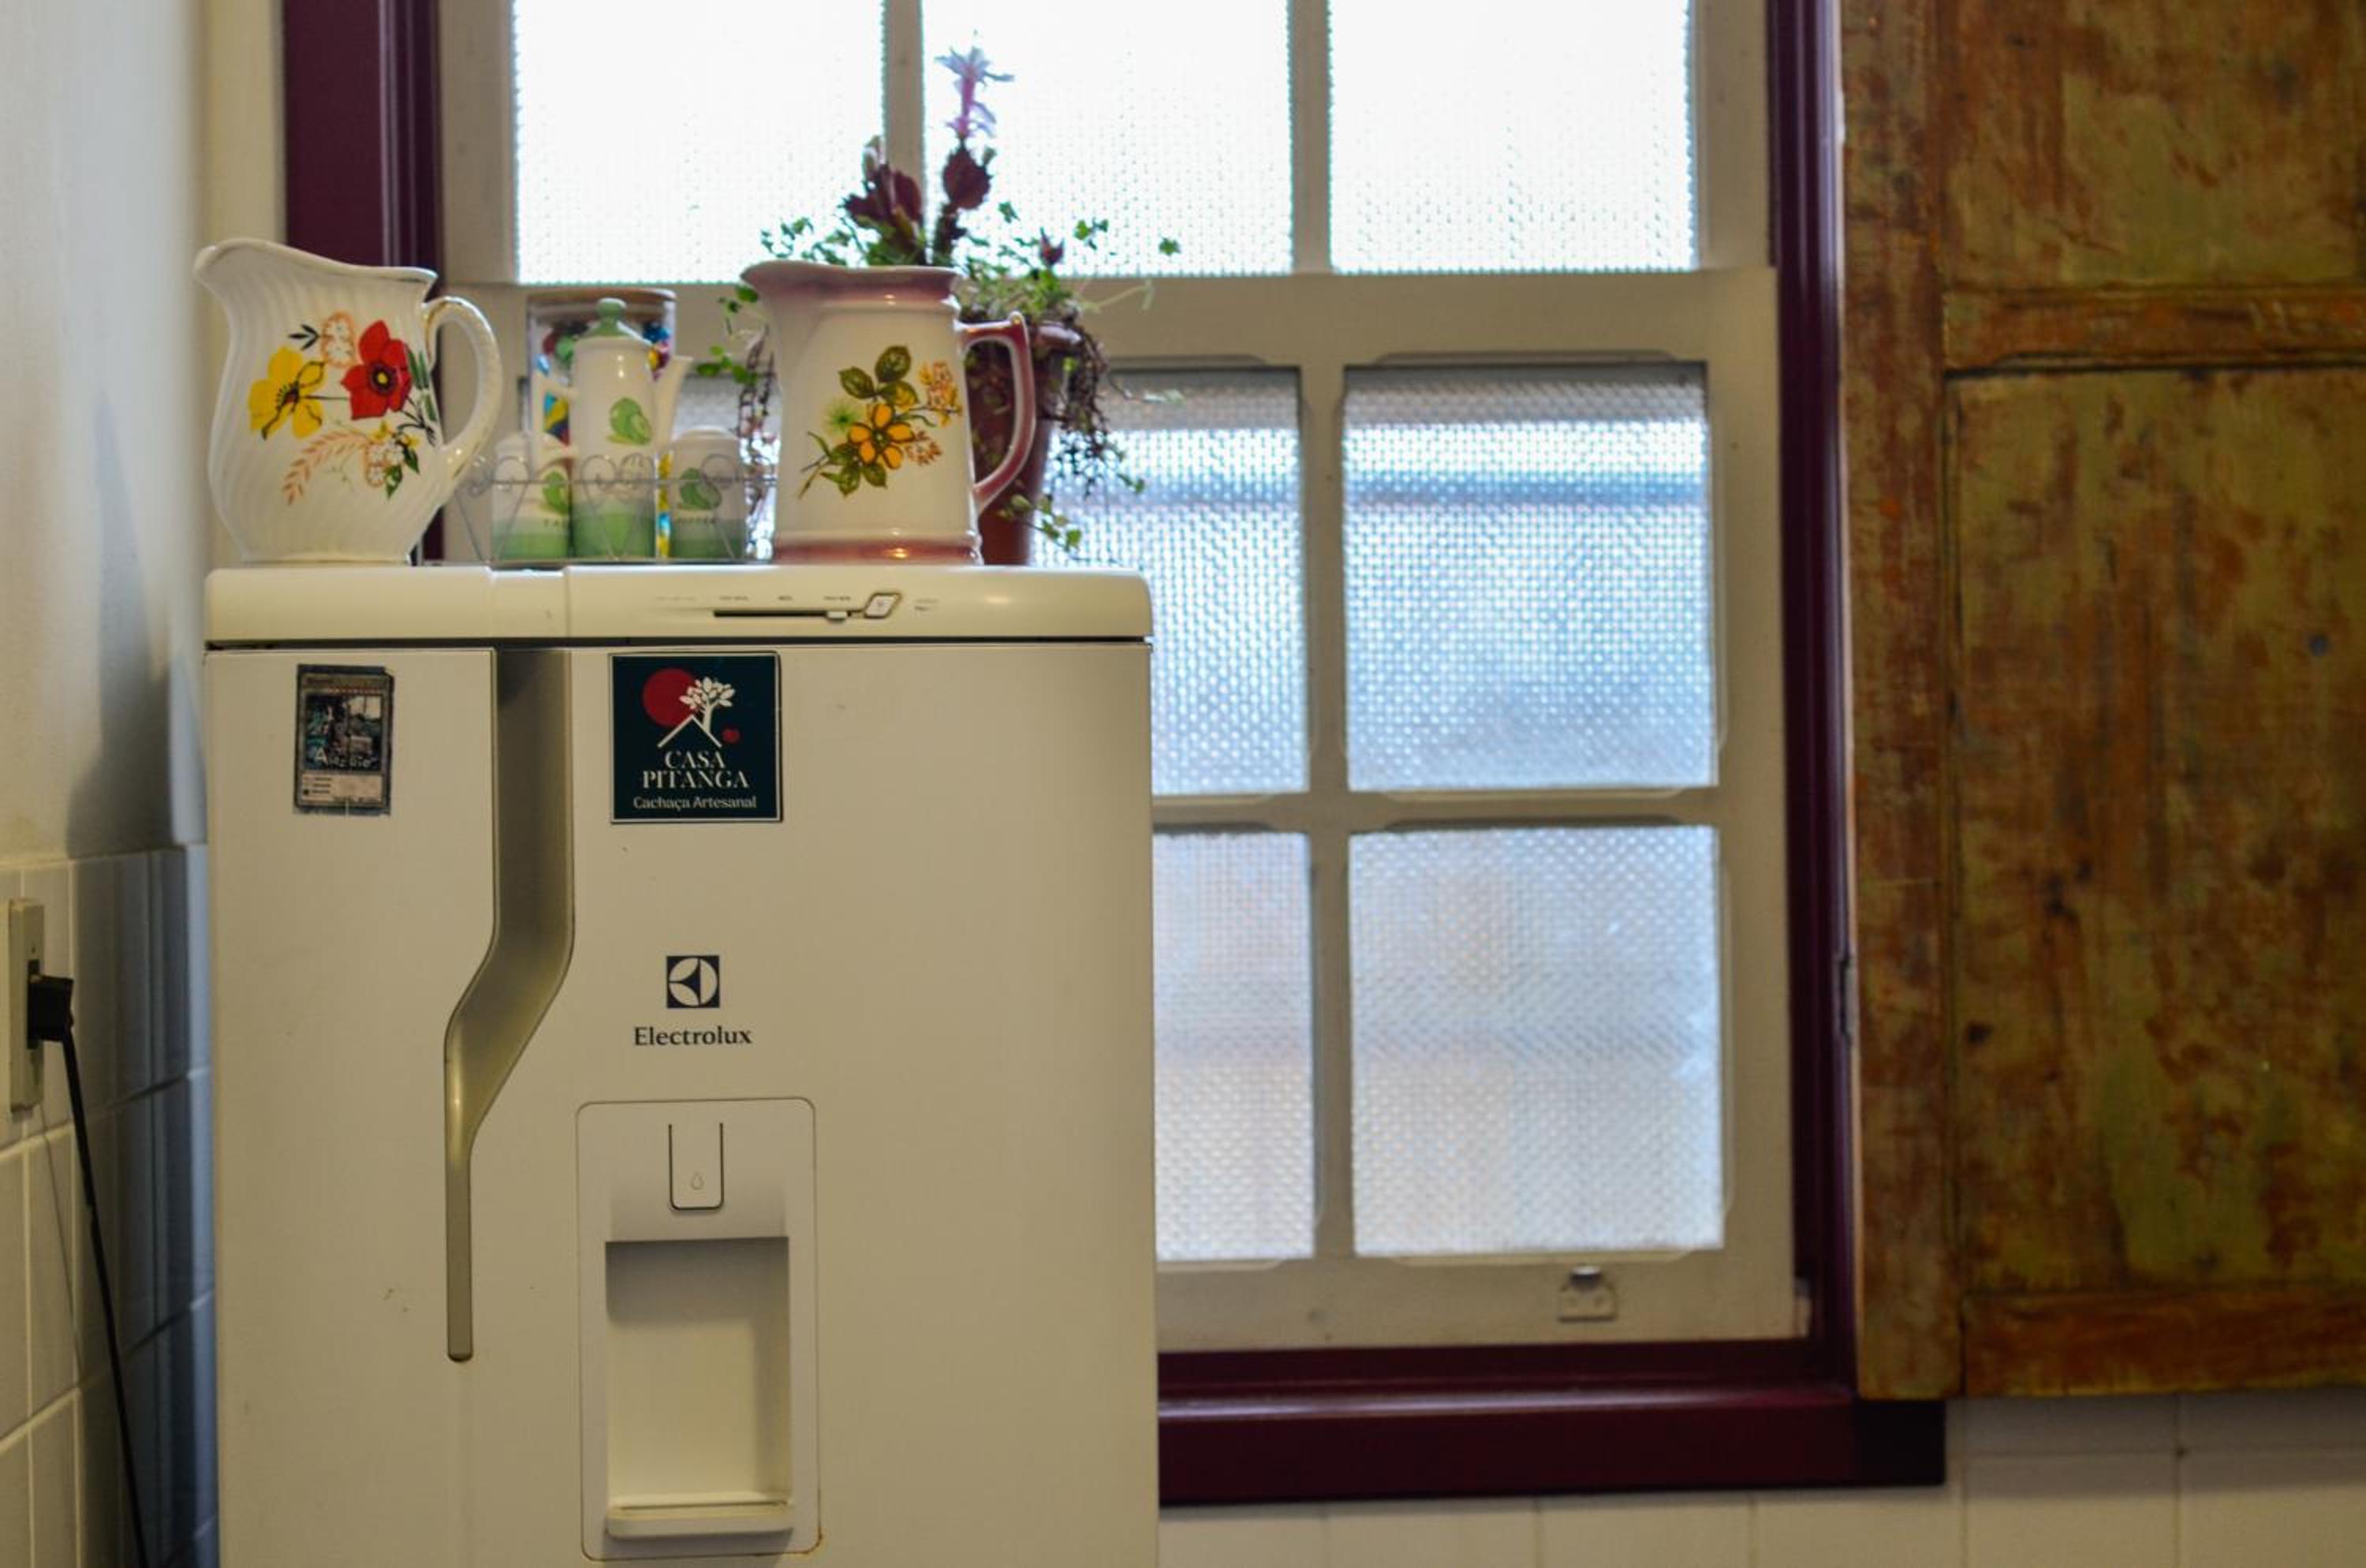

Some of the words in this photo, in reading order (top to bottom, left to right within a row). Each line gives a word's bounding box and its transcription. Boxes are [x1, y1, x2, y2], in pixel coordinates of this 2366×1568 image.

[665, 750, 725, 768] CASA
[643, 770, 749, 789] PITANGA
[633, 796, 690, 812] Cachaça
[693, 796, 757, 808] Artesanal
[634, 1025, 752, 1046] Electrolux
